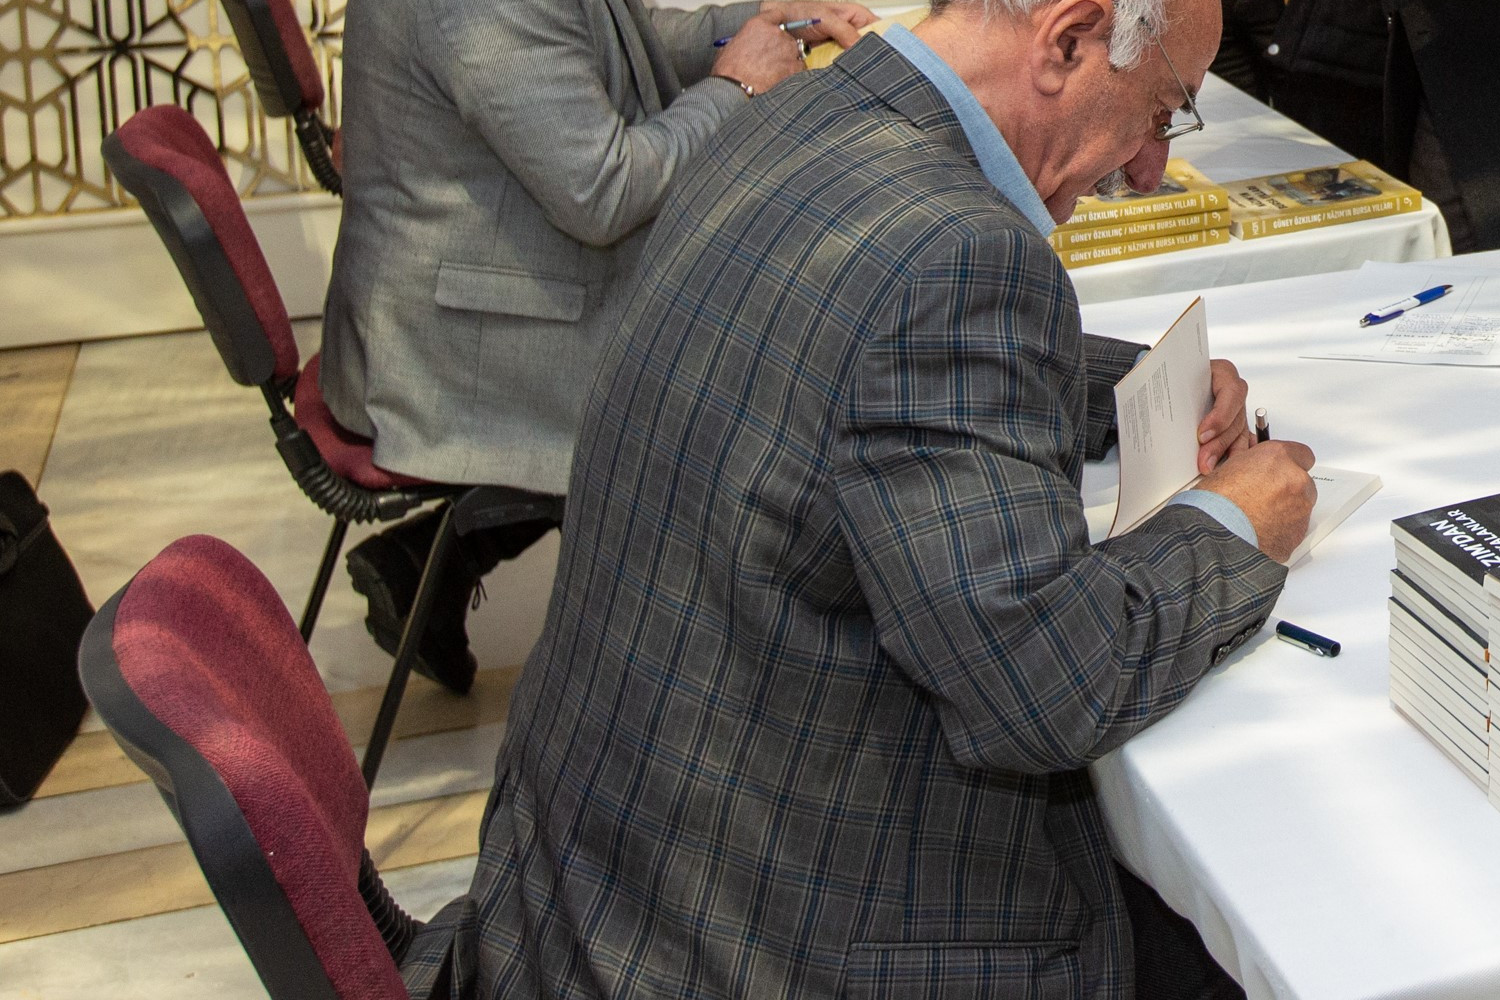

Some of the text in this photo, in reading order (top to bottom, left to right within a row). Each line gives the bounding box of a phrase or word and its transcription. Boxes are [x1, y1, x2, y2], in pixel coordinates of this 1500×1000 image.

[1153, 201, 1173, 212] BURSA
[1174, 198, 1197, 209] YILLARI
[1353, 205, 1372, 217] BURSA
[1372, 202, 1393, 213] YILLARI
[1156, 219, 1177, 230] BURSA
[1177, 216, 1200, 227] YILLARI
[1155, 238, 1176, 249] BURSA
[1176, 234, 1199, 245] YILLARI
